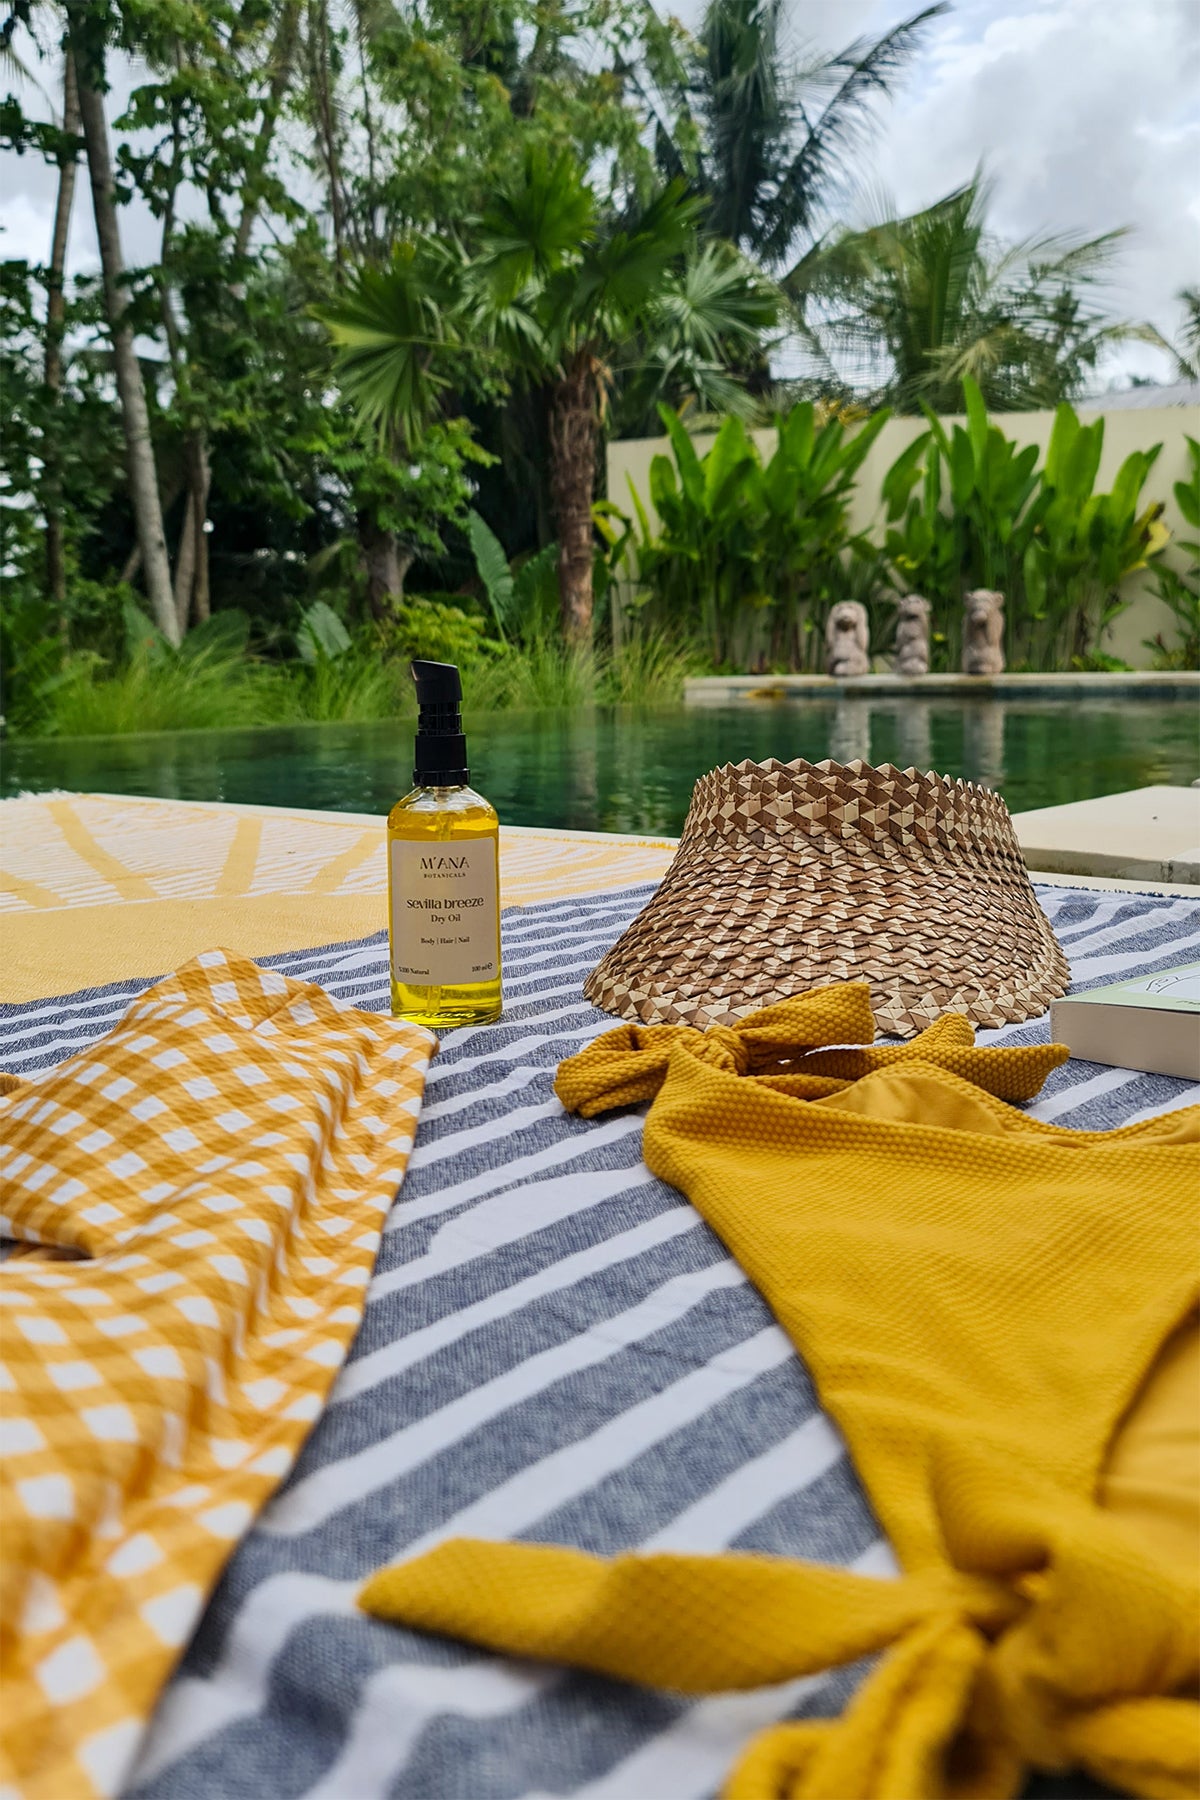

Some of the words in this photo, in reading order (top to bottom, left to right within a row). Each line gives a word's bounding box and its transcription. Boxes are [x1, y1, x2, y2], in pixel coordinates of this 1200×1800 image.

[406, 898, 442, 909] sevilla
[444, 896, 484, 909] breeze
[431, 914, 445, 924] Dry
[448, 914, 461, 922] Oil
[410, 967, 430, 975] Natural
